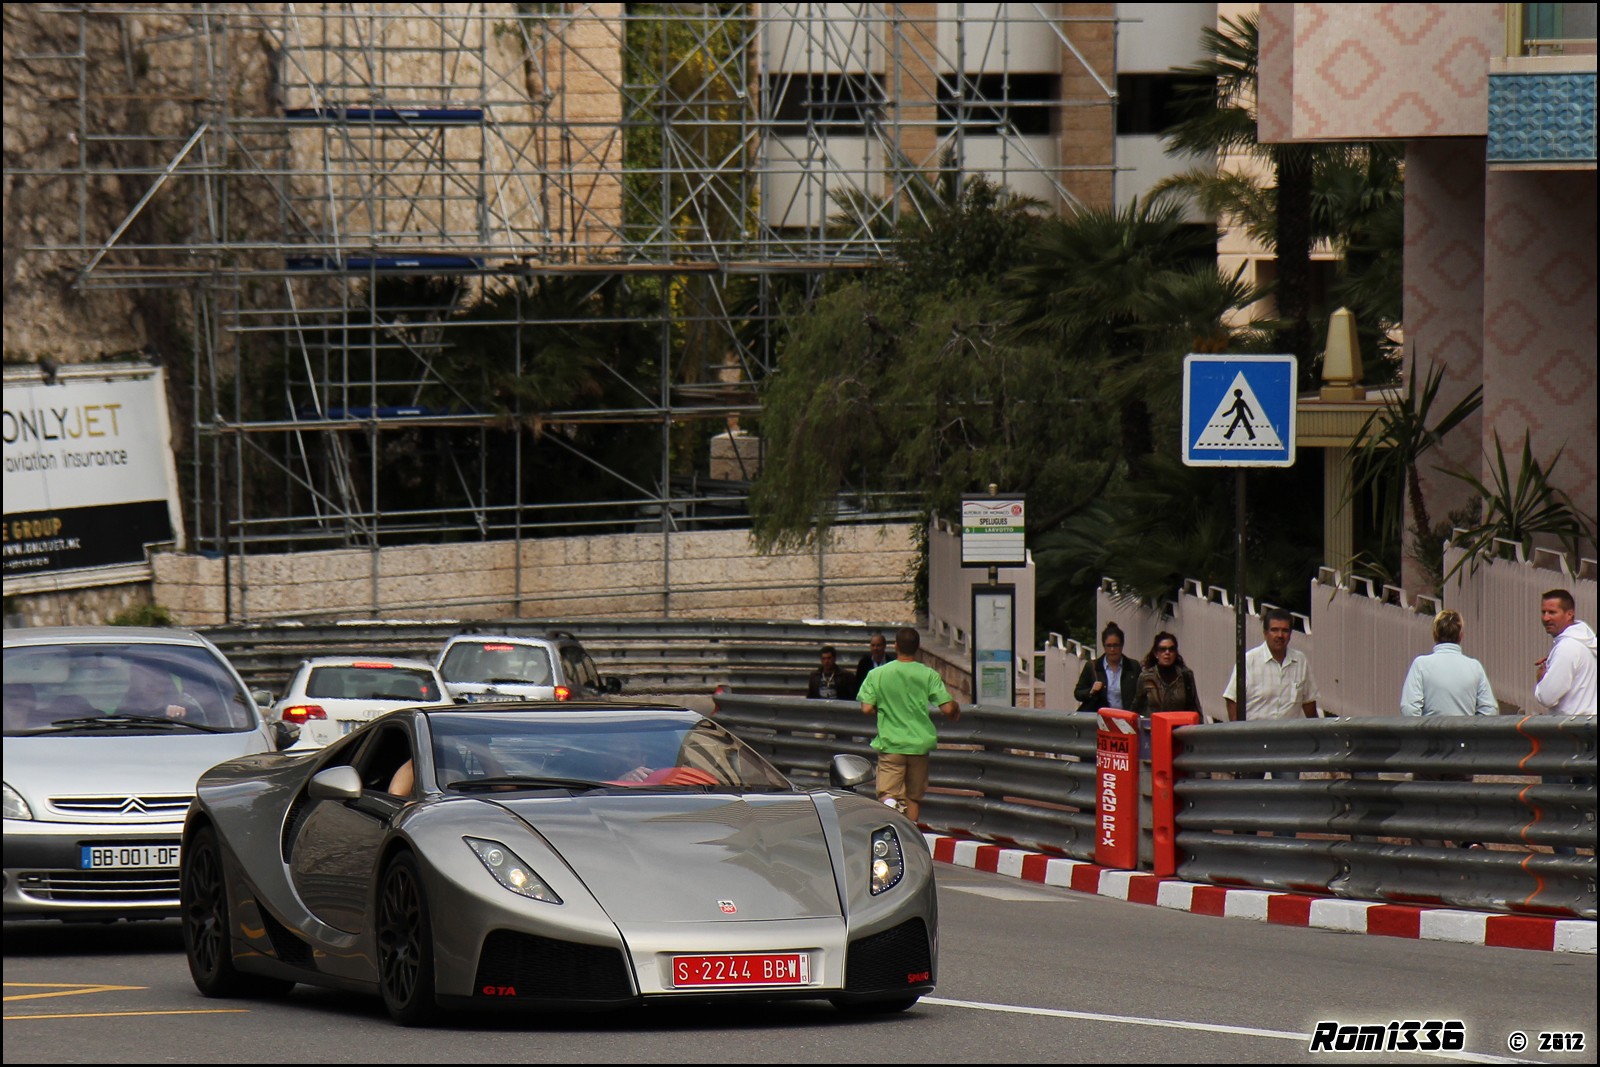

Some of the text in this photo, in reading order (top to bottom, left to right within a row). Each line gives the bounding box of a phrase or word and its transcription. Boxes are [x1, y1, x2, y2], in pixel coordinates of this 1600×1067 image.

[3, 403, 122, 444] ONLYJET
[5, 448, 128, 473] aviation insurance
[12, 517, 63, 540] GROUP
[1110, 741, 1129, 753] MAI
[1113, 759, 1129, 772] MAI
[1103, 773, 1116, 812] GRAND
[1102, 814, 1116, 847] PRIX
[92, 848, 178, 866] BB-001-DF
[483, 985, 516, 996] GTA
